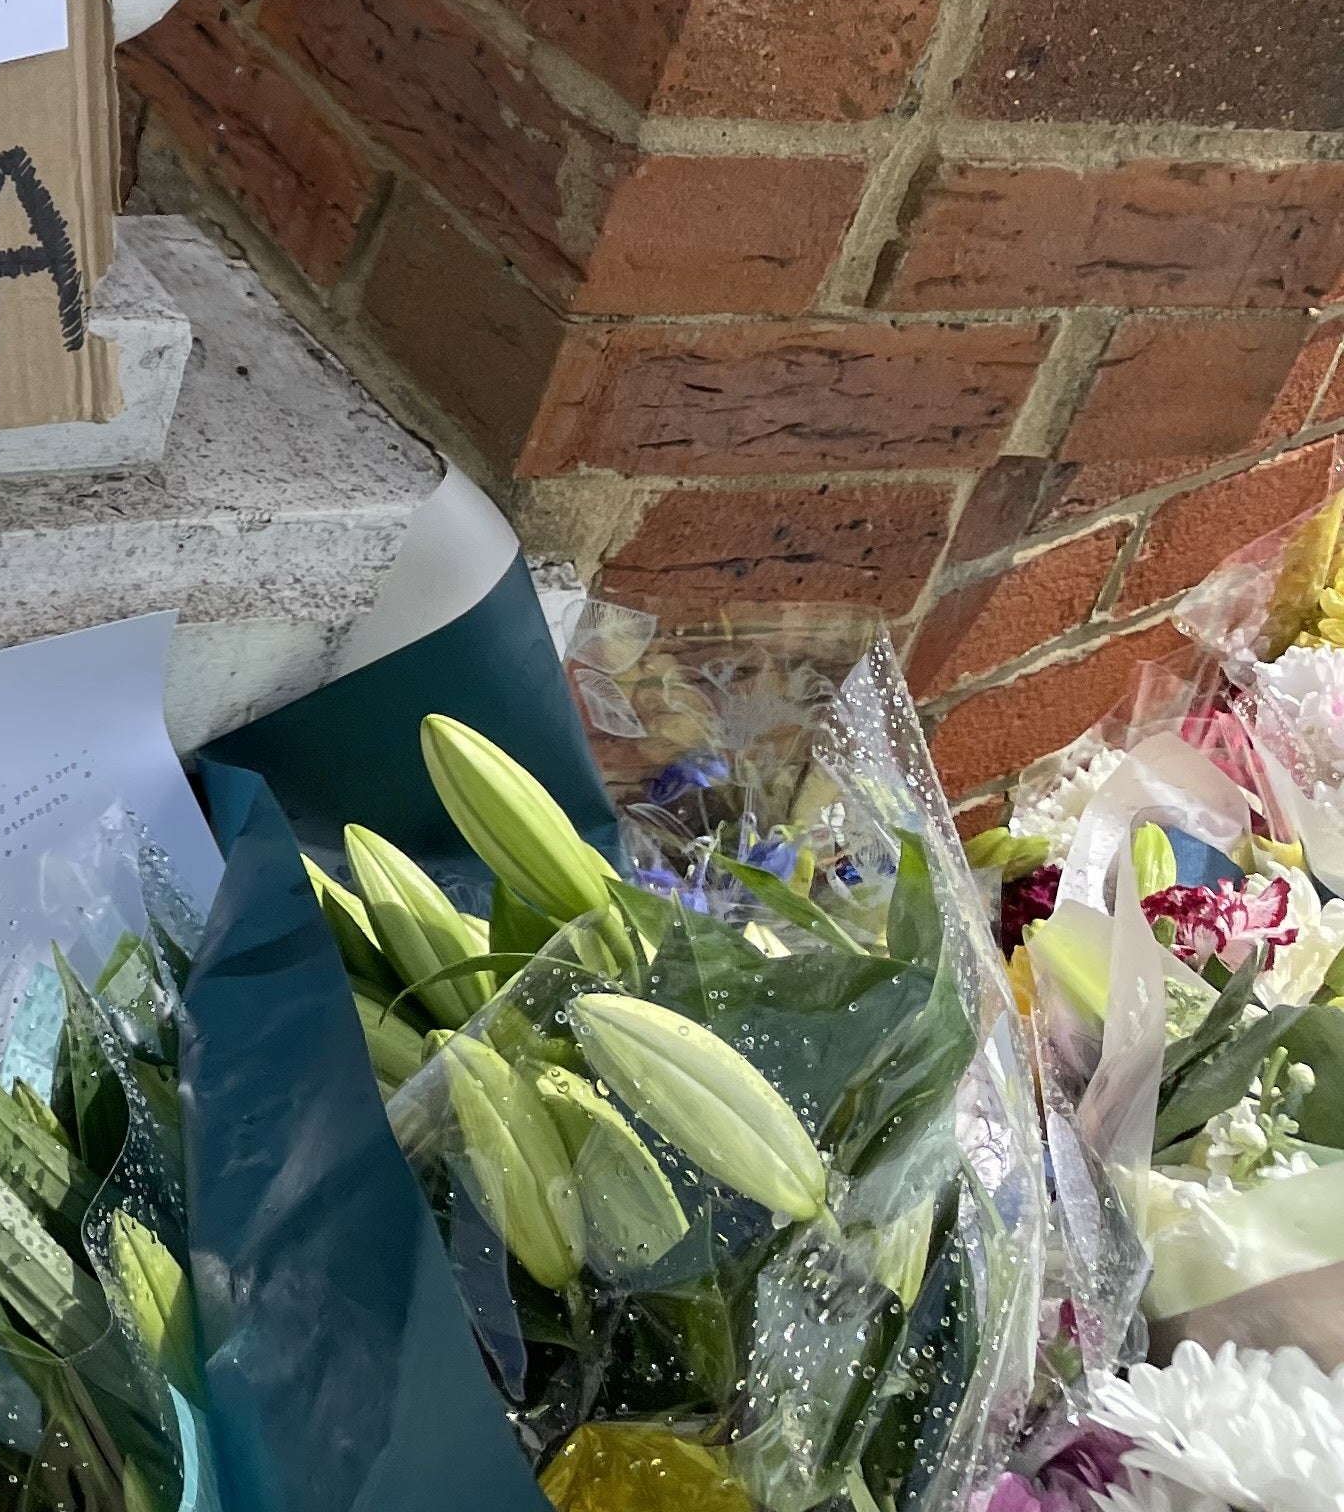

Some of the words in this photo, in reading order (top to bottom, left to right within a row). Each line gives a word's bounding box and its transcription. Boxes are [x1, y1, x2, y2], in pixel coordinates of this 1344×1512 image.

[14, 784, 39, 806] you
[46, 762, 78, 784] love
[3, 792, 69, 836] strength
